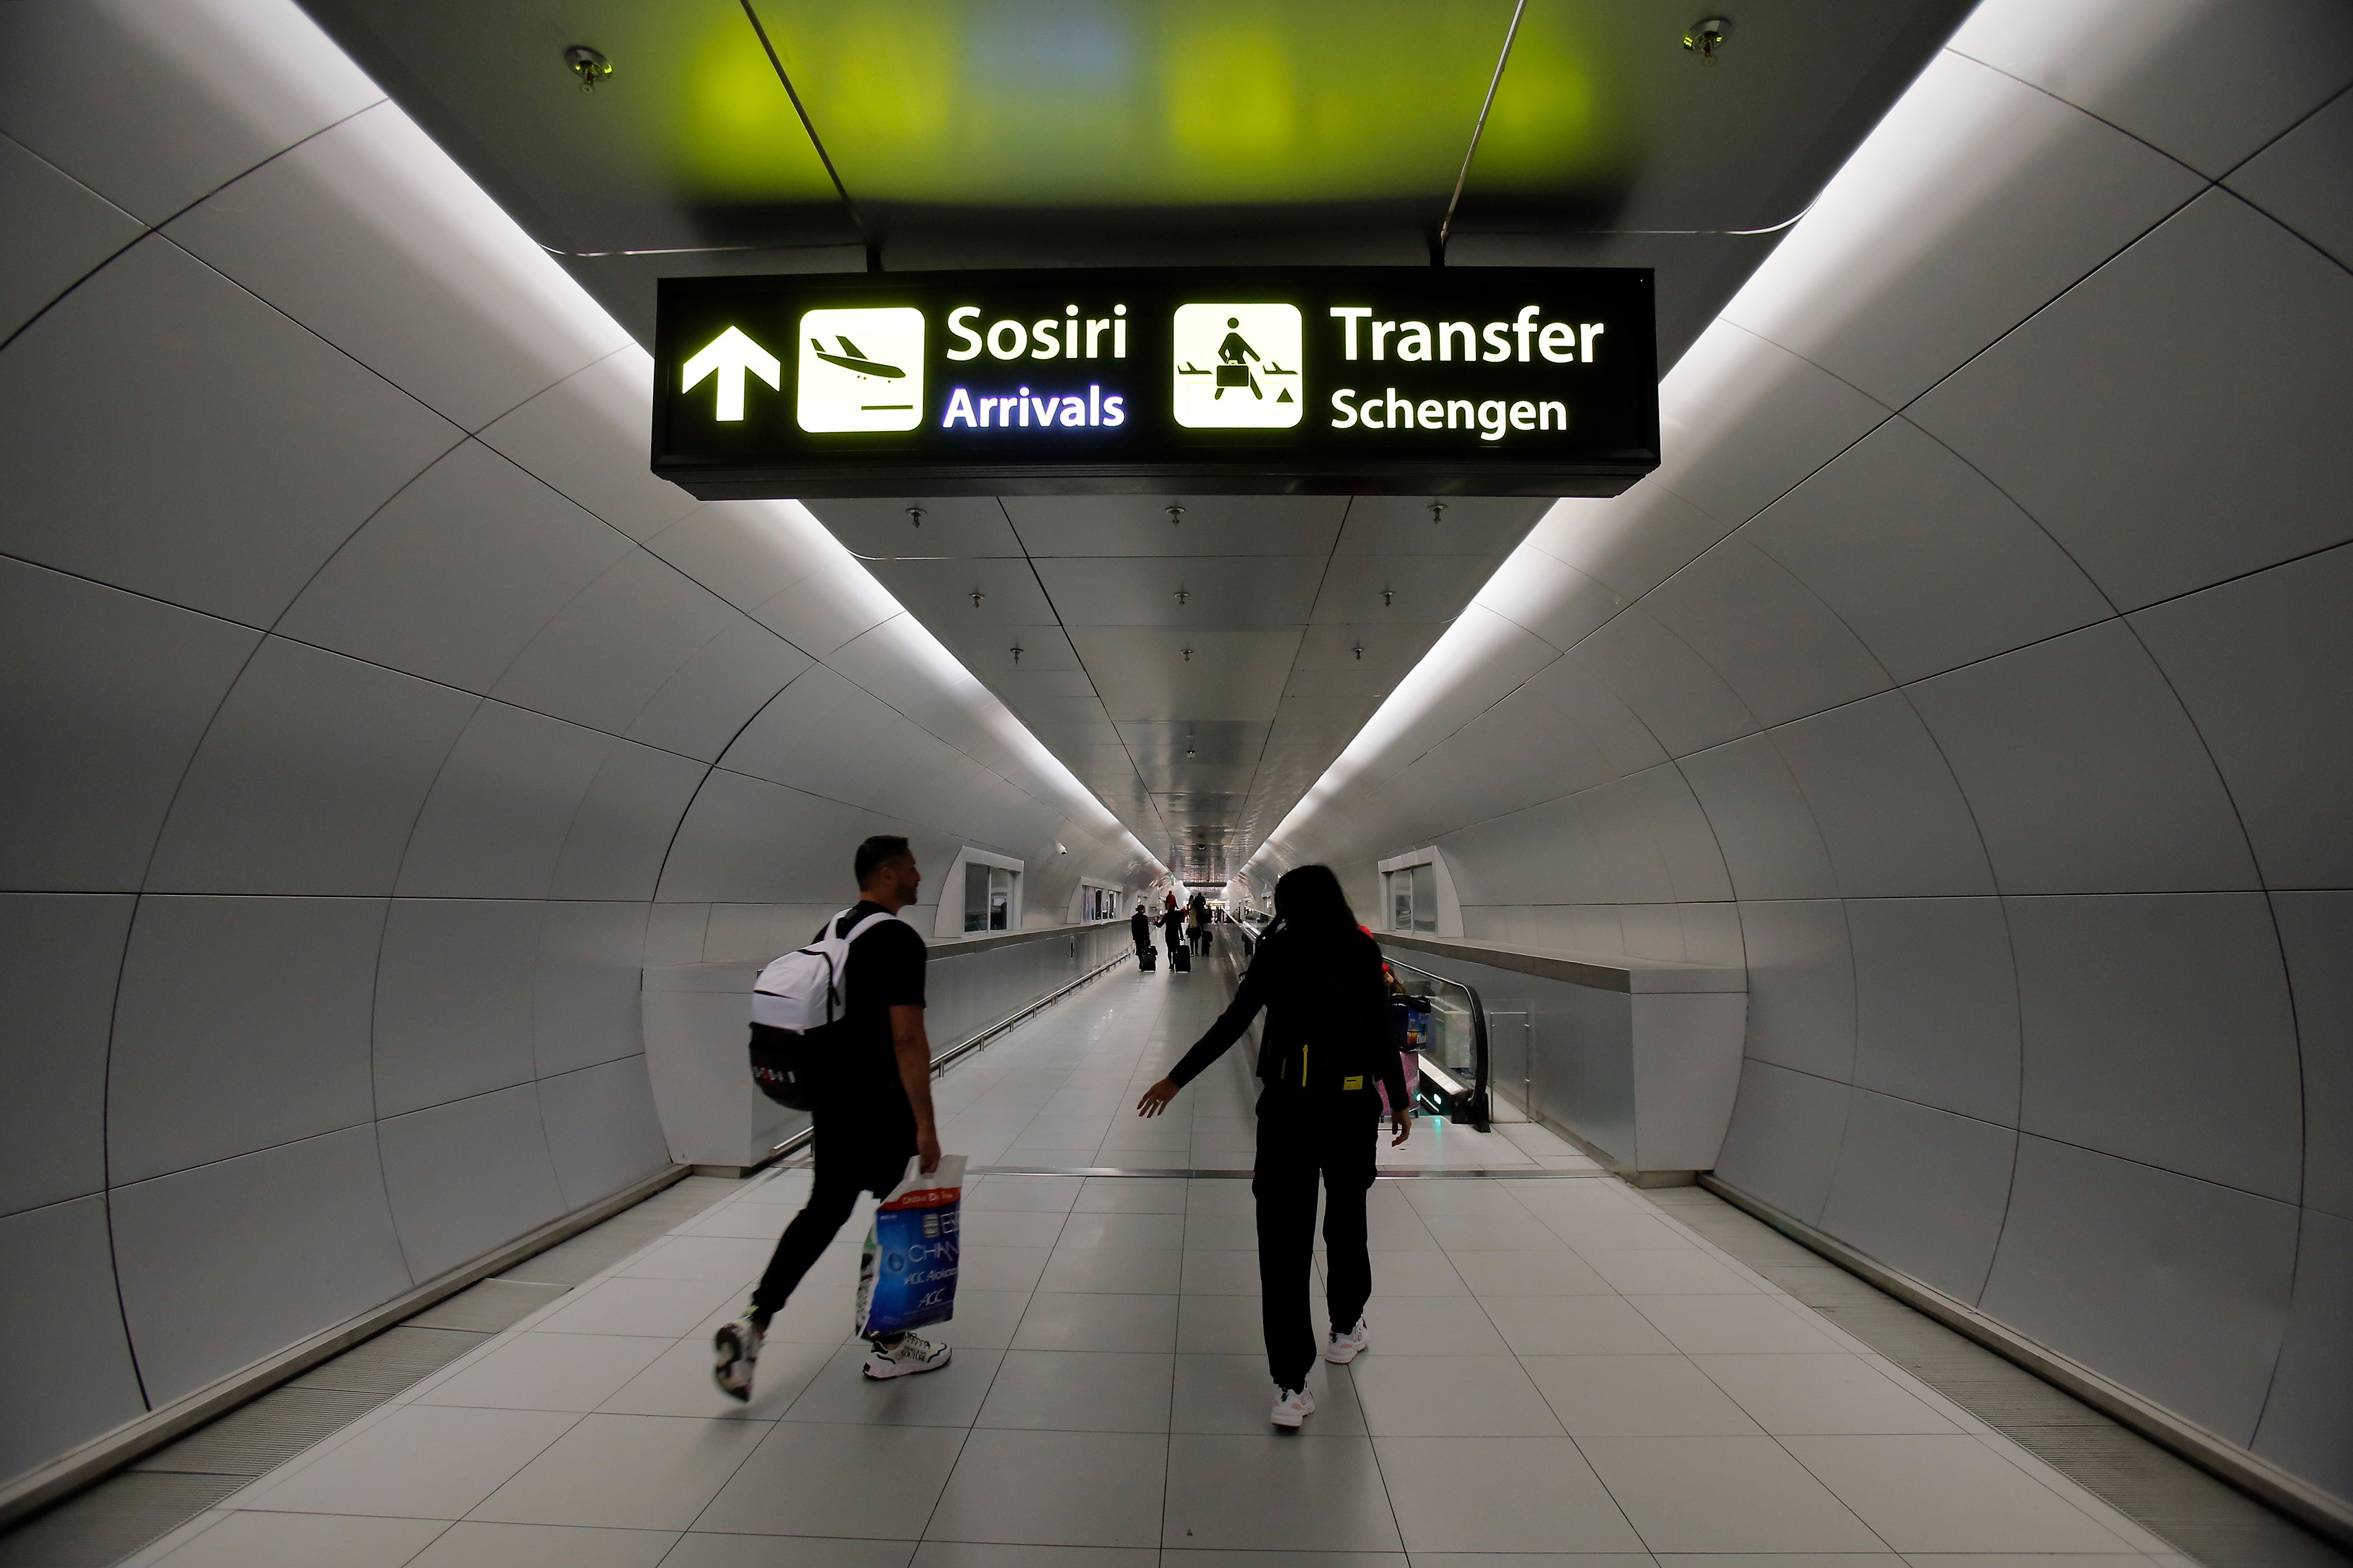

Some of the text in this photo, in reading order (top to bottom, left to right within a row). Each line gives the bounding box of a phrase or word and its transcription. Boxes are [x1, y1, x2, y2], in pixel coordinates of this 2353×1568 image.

[946, 303, 1127, 361] Sosiri
[1329, 305, 1605, 363] Transfer
[941, 384, 1126, 428] Arrivals
[1331, 387, 1567, 442] Schengen
